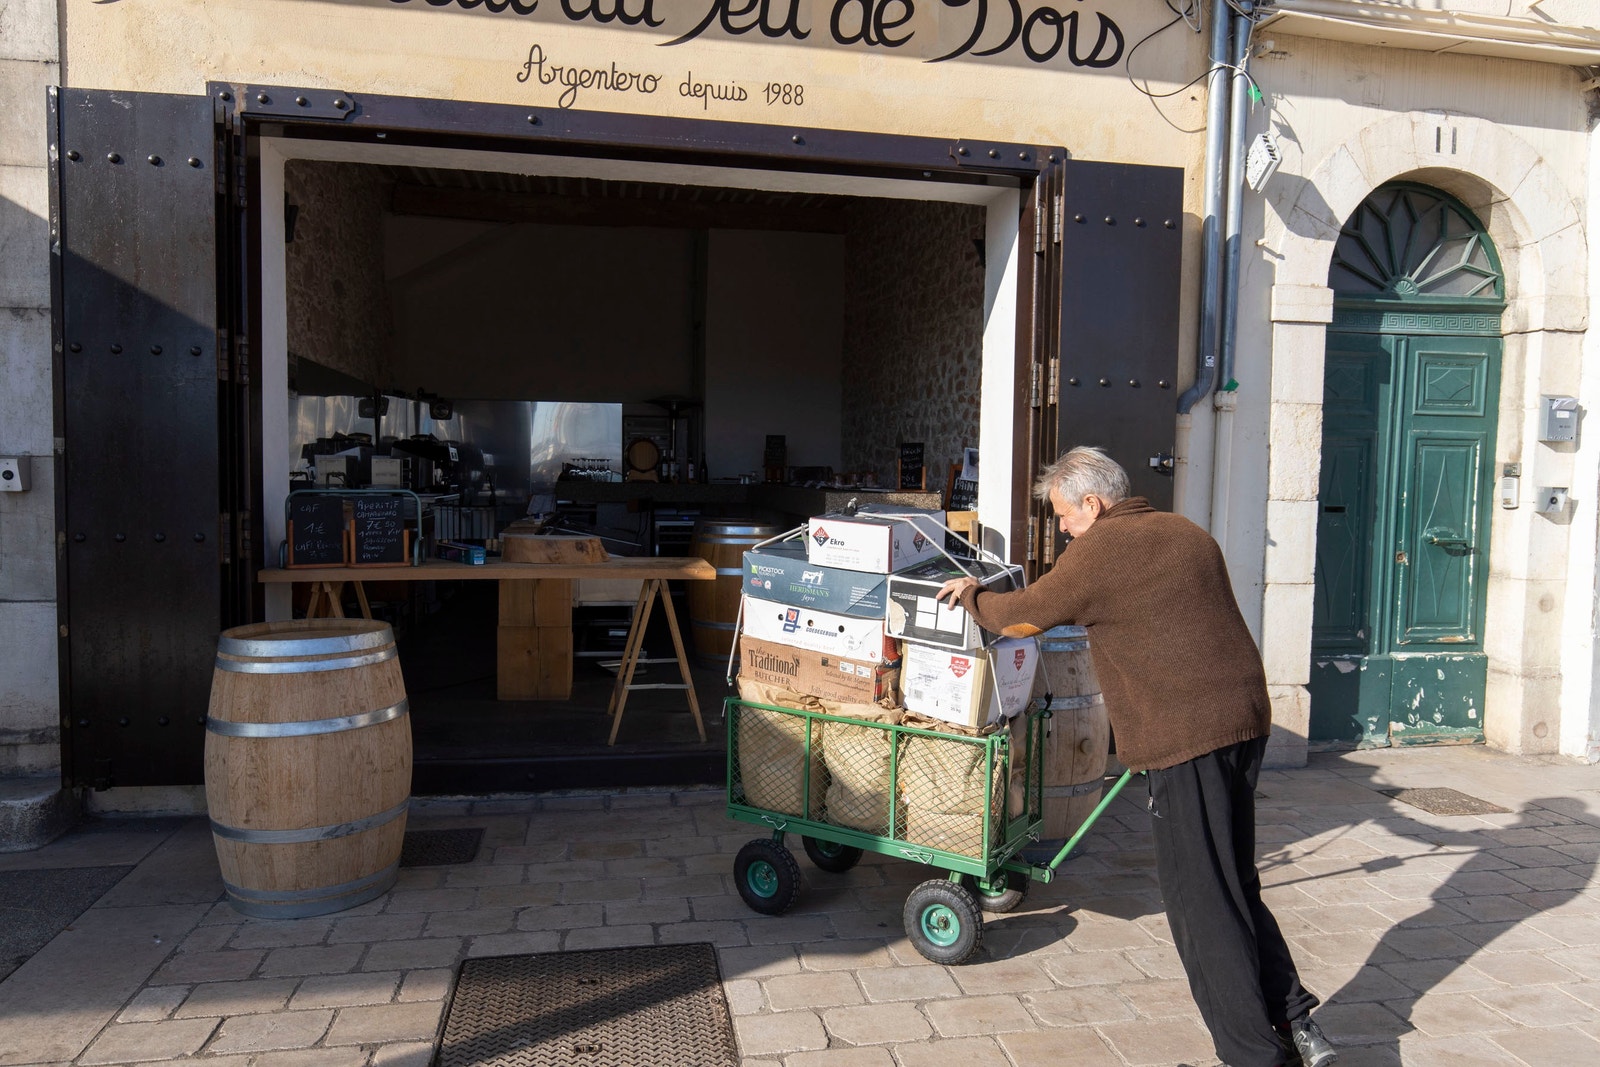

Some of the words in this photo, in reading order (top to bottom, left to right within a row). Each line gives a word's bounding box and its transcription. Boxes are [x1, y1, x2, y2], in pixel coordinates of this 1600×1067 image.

[516, 44, 664, 109] Argentero
[679, 71, 749, 110] depuis
[763, 82, 805, 106] 1988
[829, 538, 845, 547] Ekro
[749, 650, 799, 677] Traditional
[755, 671, 791, 686] BUTCHER
